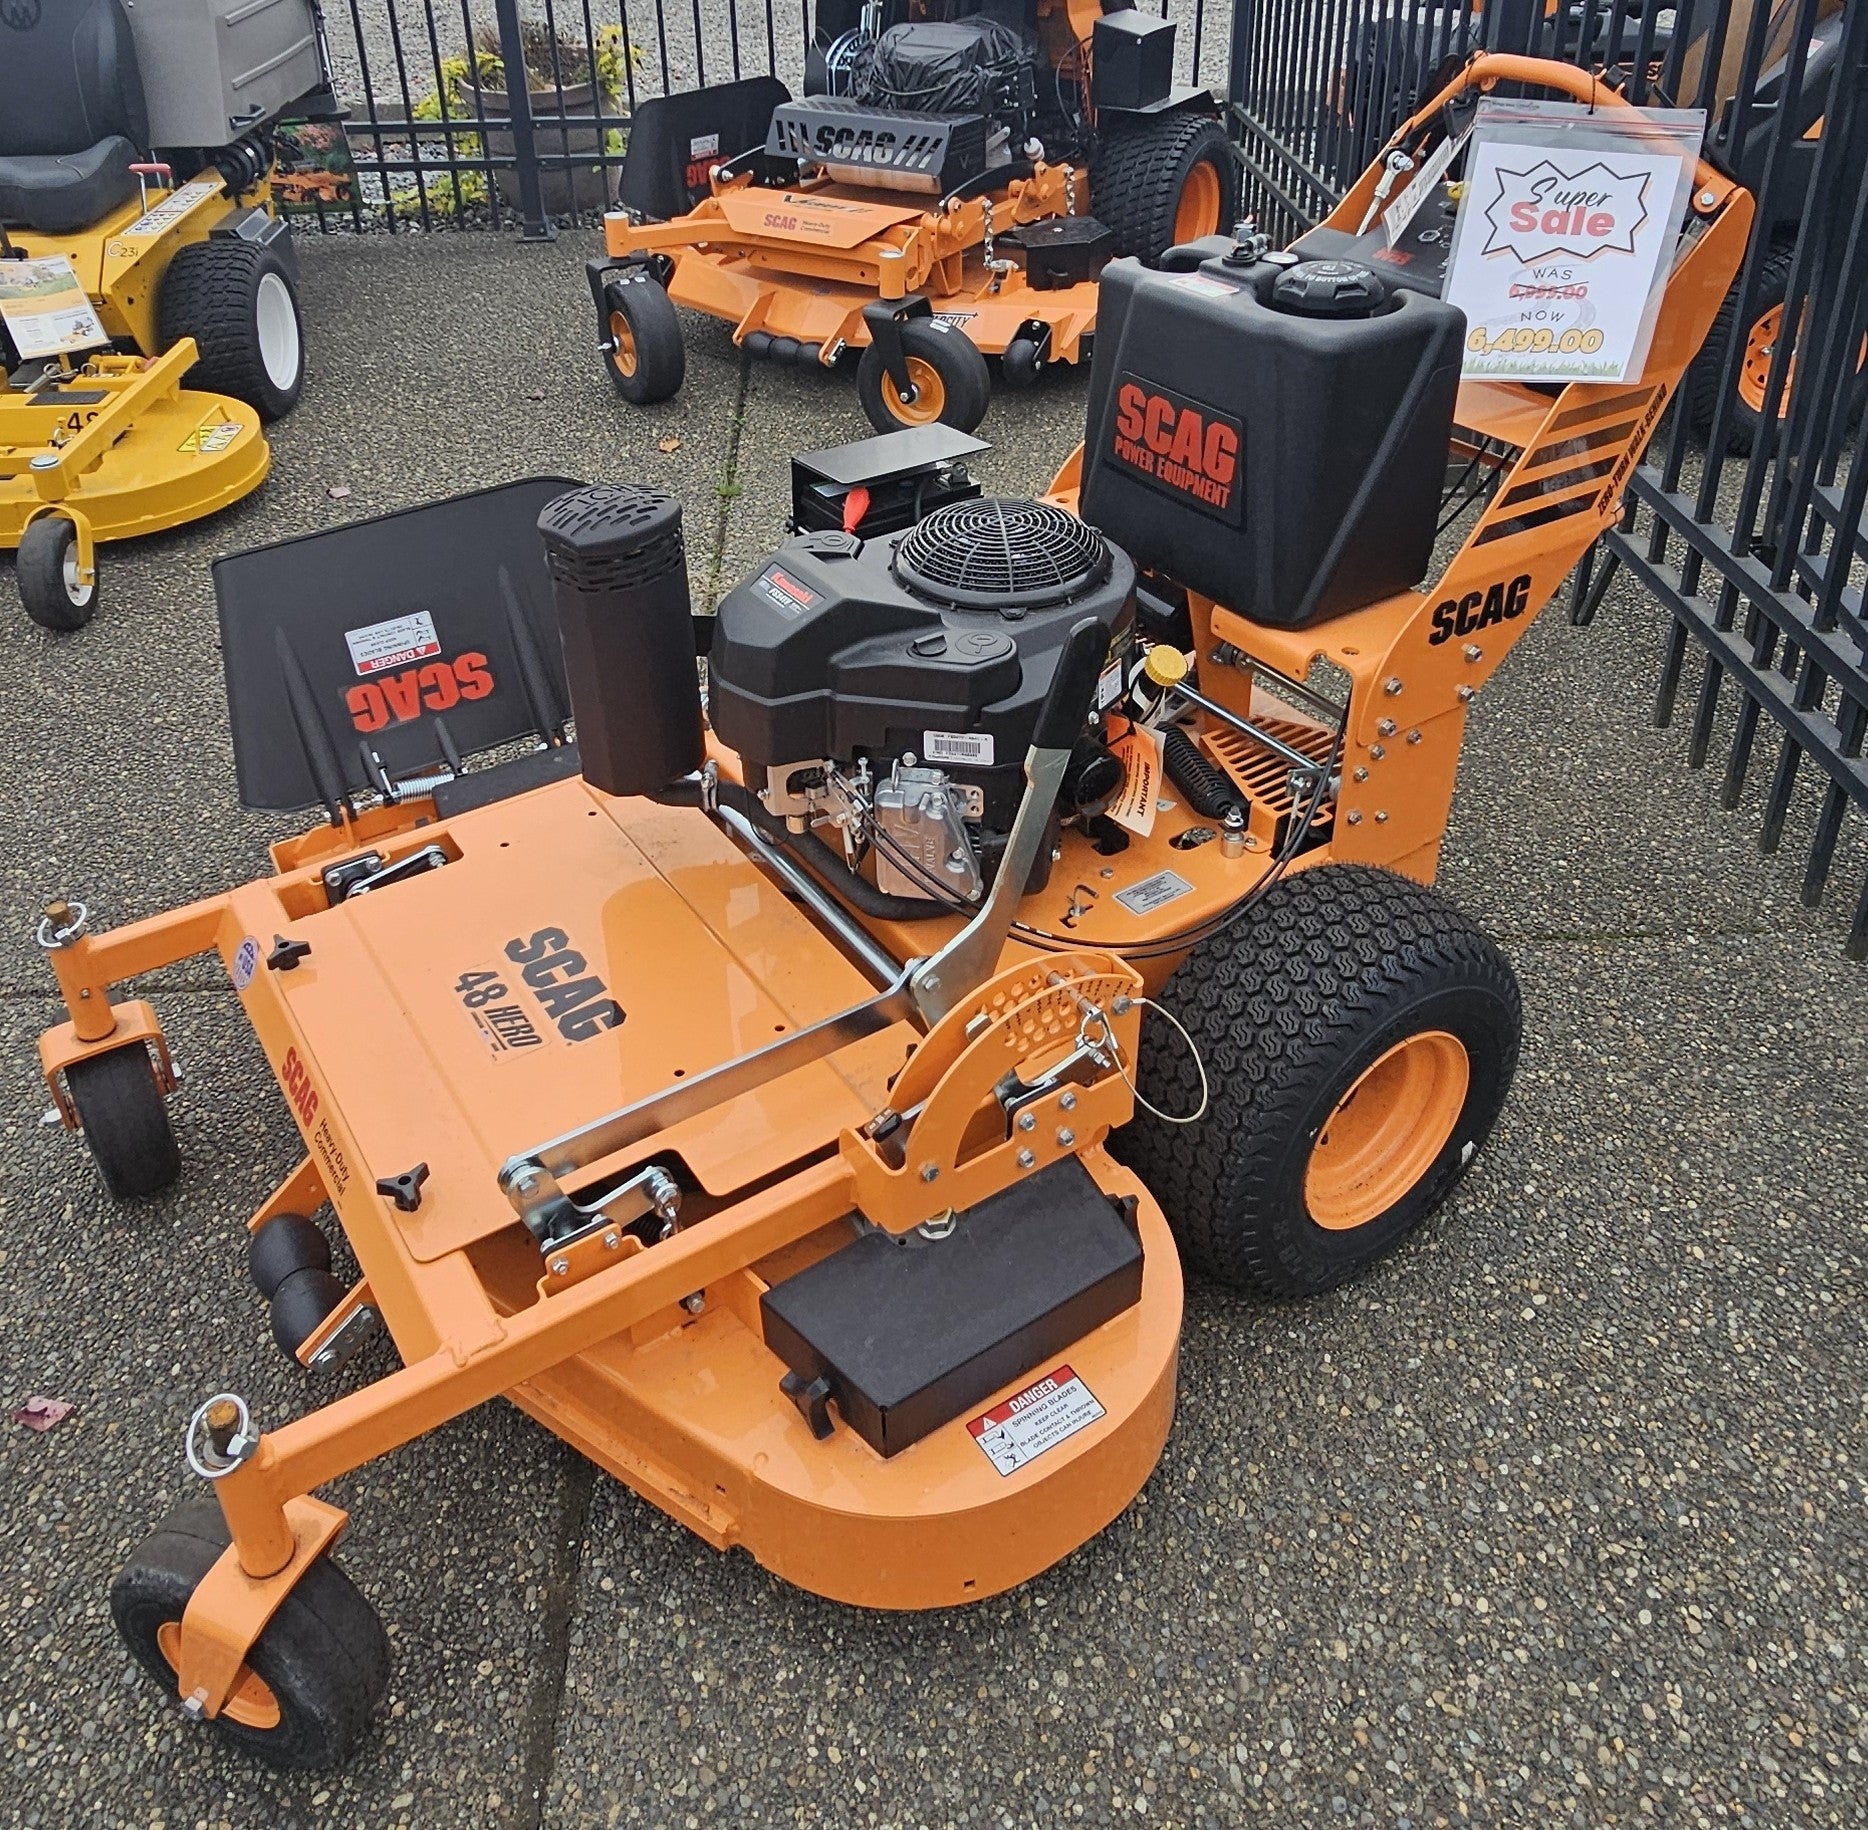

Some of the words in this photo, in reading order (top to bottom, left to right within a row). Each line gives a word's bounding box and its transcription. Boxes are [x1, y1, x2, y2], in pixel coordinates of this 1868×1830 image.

[814, 125, 896, 164] SCAG
[1529, 176, 1612, 213] Super
[764, 213, 797, 230] SCAG
[1509, 201, 1615, 237] Sale
[1533, 267, 1573, 280] WAS
[1520, 310, 1565, 323] NOW
[1467, 326, 1604, 357] 6,499.00
[1117, 383, 1238, 485] SCAG
[1114, 435, 1154, 473] POWER
[1156, 457, 1231, 509] EQUIPMENT
[1428, 573, 1532, 646] SCAG
[370, 649, 415, 668] DANGER
[345, 652, 494, 732] SCAG
[1136, 763, 1150, 818] IMPORTANT
[504, 926, 627, 1042] SCAG
[454, 970, 509, 1009] 48
[483, 1004, 543, 1048] HERO
[282, 1046, 318, 1128] SCAG
[314, 1131, 347, 1197] Commercial
[320, 1118, 350, 1182] Heavy-Duty
[1008, 1378, 1059, 1414] DANGER
[1012, 1402, 1048, 1428] SPINNING
[1048, 1385, 1078, 1406] BLADES
[1034, 1413, 1049, 1427] KEEP
[1050, 1403, 1069, 1417] CLEAR
[1020, 1433, 1039, 1448] BLADE
[1039, 1417, 1065, 1435] CONTACT
[1071, 1399, 1095, 1416] THROWN
[1033, 1431, 1060, 1449] OBJECTS
[1060, 1422, 1072, 1432] CAN
[1071, 1410, 1092, 1425] INJURE
